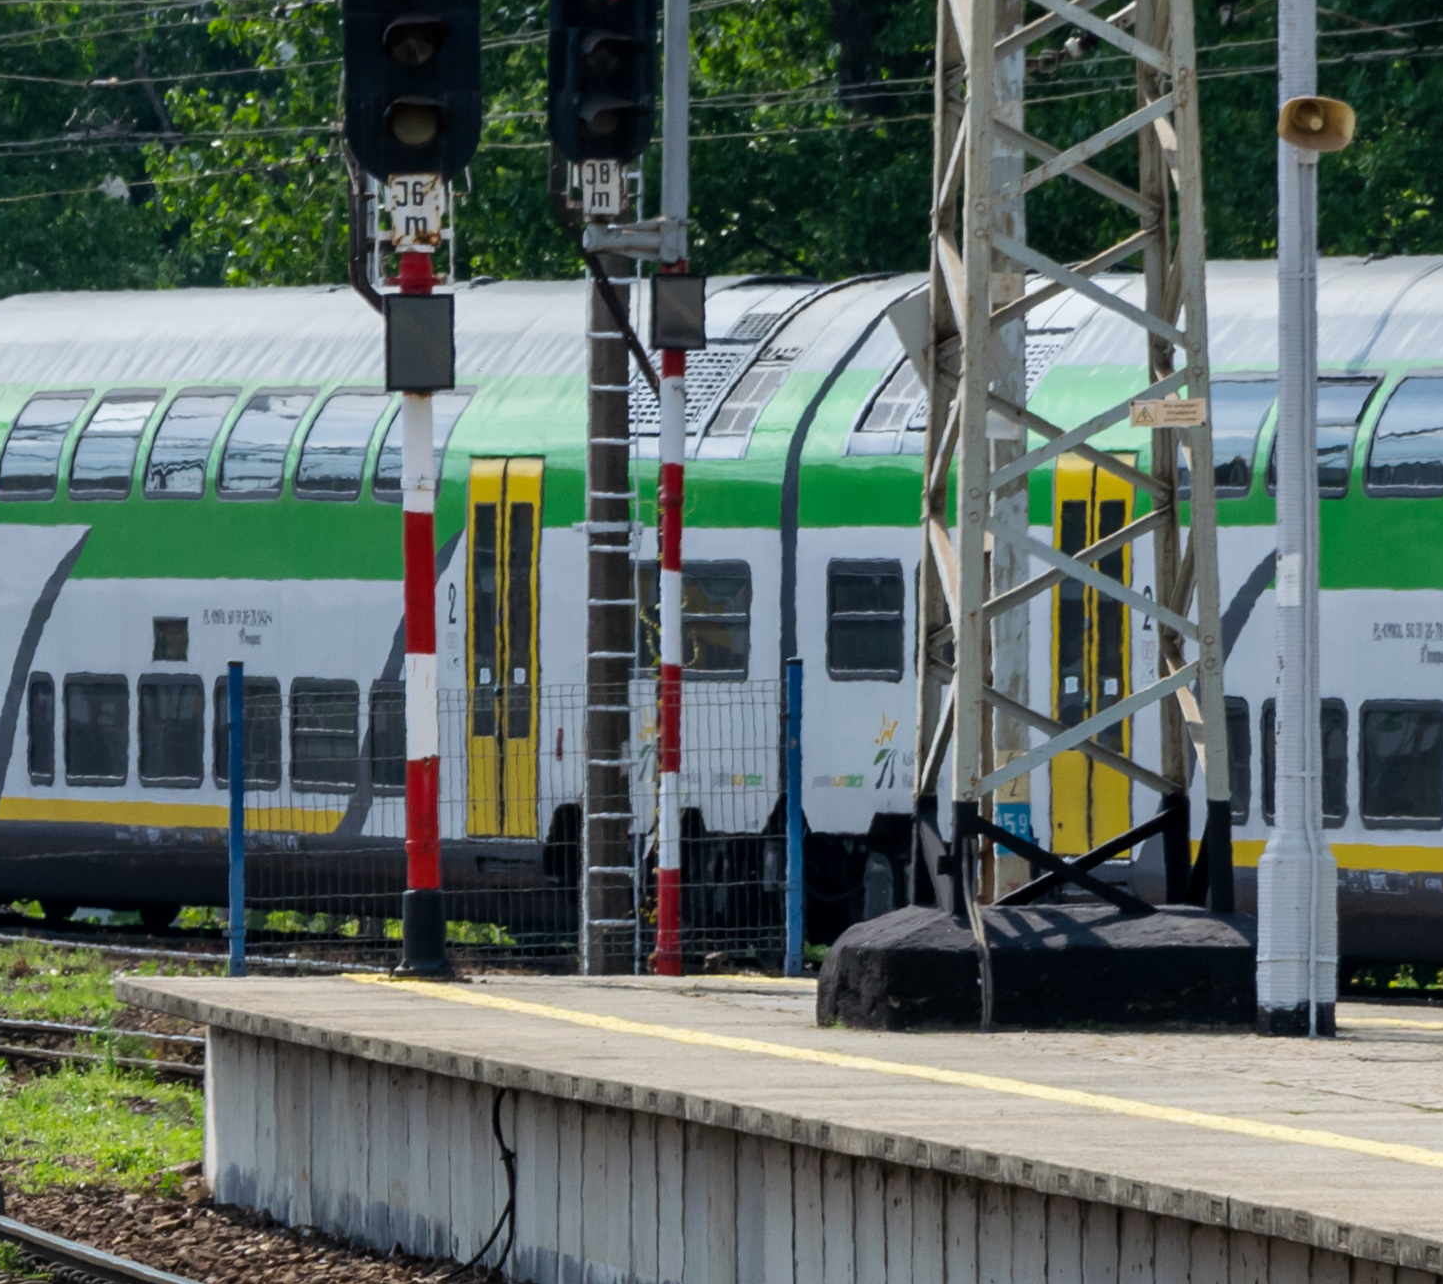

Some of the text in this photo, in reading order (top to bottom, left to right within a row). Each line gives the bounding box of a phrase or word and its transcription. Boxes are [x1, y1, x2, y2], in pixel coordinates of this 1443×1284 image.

[394, 180, 424, 207] J6
[592, 191, 610, 208] m
[405, 216, 428, 236] m
[448, 583, 457, 624] 2
[1143, 585, 1153, 631] 2
